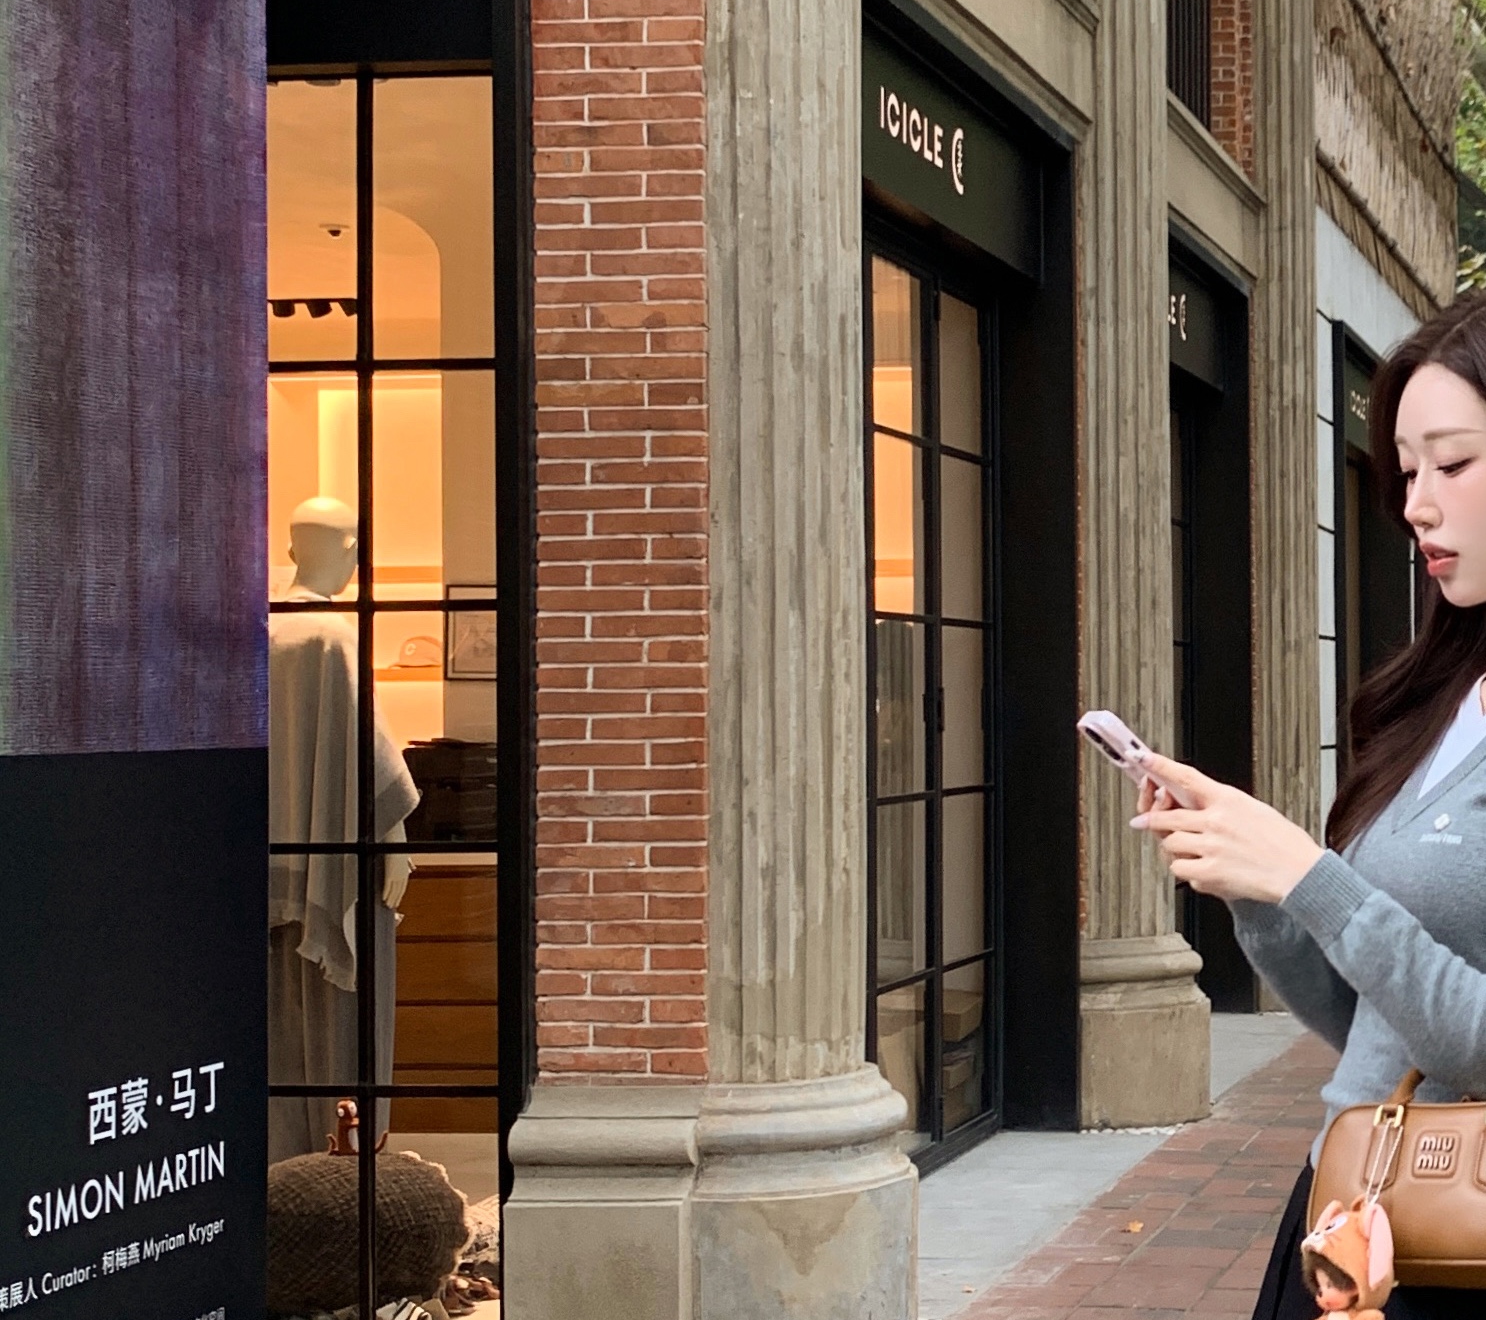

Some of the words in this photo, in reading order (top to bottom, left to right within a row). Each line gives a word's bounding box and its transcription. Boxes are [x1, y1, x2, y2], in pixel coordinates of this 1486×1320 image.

[880, 85, 944, 169] ICICLE
[87, 1061, 225, 1145] 西蒙·马丁
[27, 1170, 125, 1237] SIMON
[134, 1140, 225, 1205] MARTIN
[142, 1233, 186, 1261] Myriam
[188, 1219, 225, 1245] Kryger
